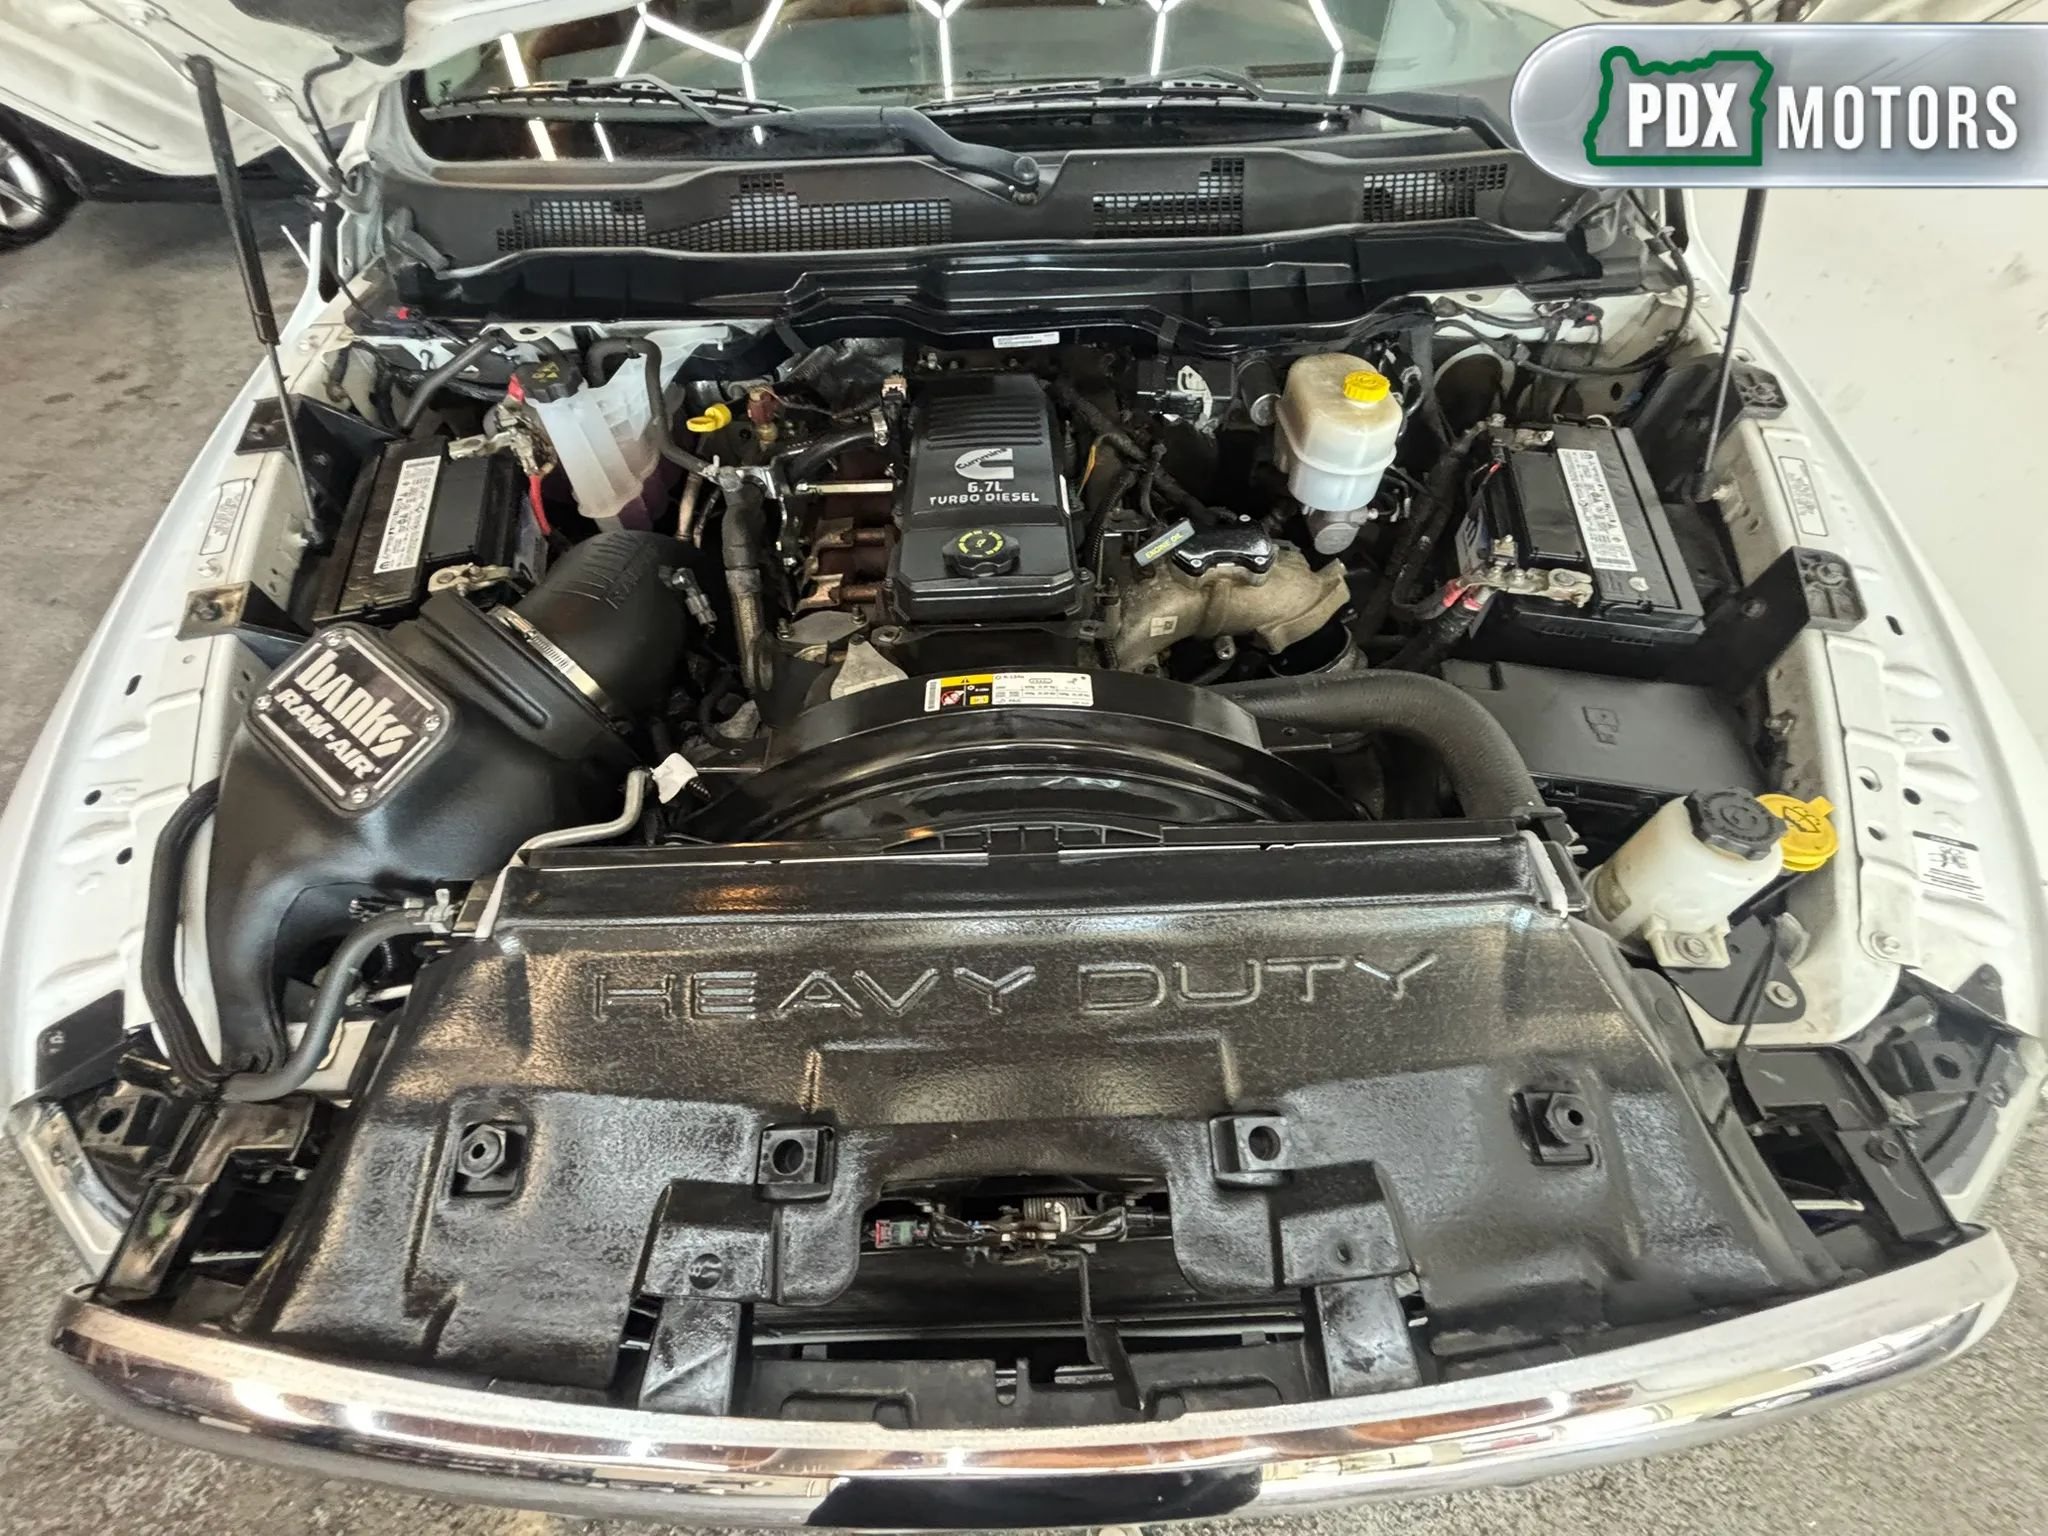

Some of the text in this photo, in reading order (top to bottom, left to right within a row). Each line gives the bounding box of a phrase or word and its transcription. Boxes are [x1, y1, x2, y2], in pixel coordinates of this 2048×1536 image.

[967, 480, 1003, 493] 6.7L
[929, 492, 1040, 506] TURBO DIESEL
[592, 952, 1439, 1020] HEAVY DUTY
